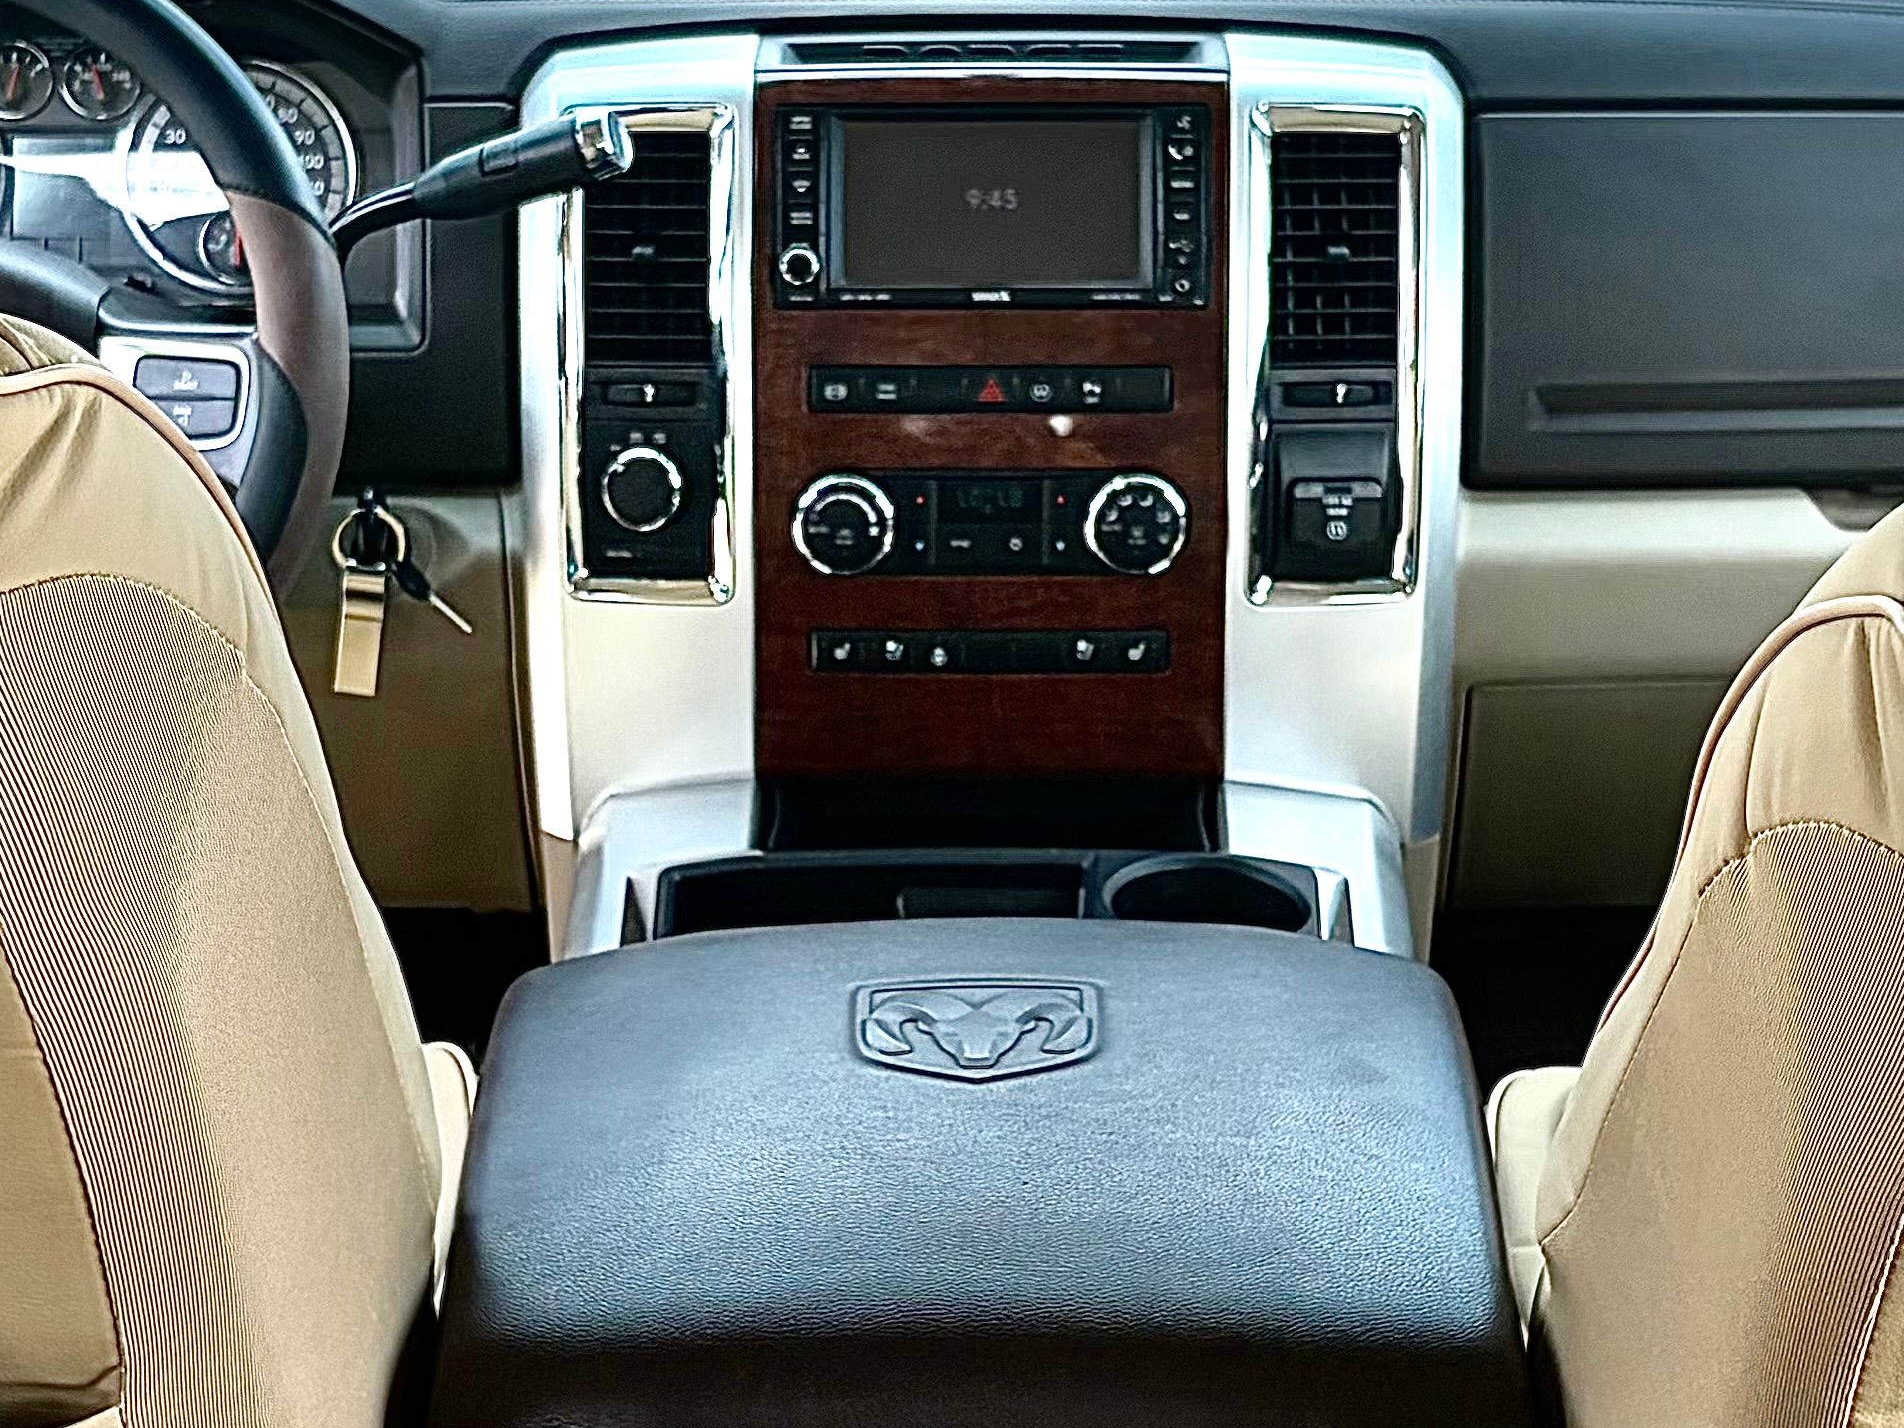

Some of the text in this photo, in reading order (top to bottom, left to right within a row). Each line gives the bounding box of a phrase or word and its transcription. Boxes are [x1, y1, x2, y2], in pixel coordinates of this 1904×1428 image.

[163, 127, 187, 145] 30
[295, 128, 316, 146] 90
[965, 189, 1018, 210] 9:45
